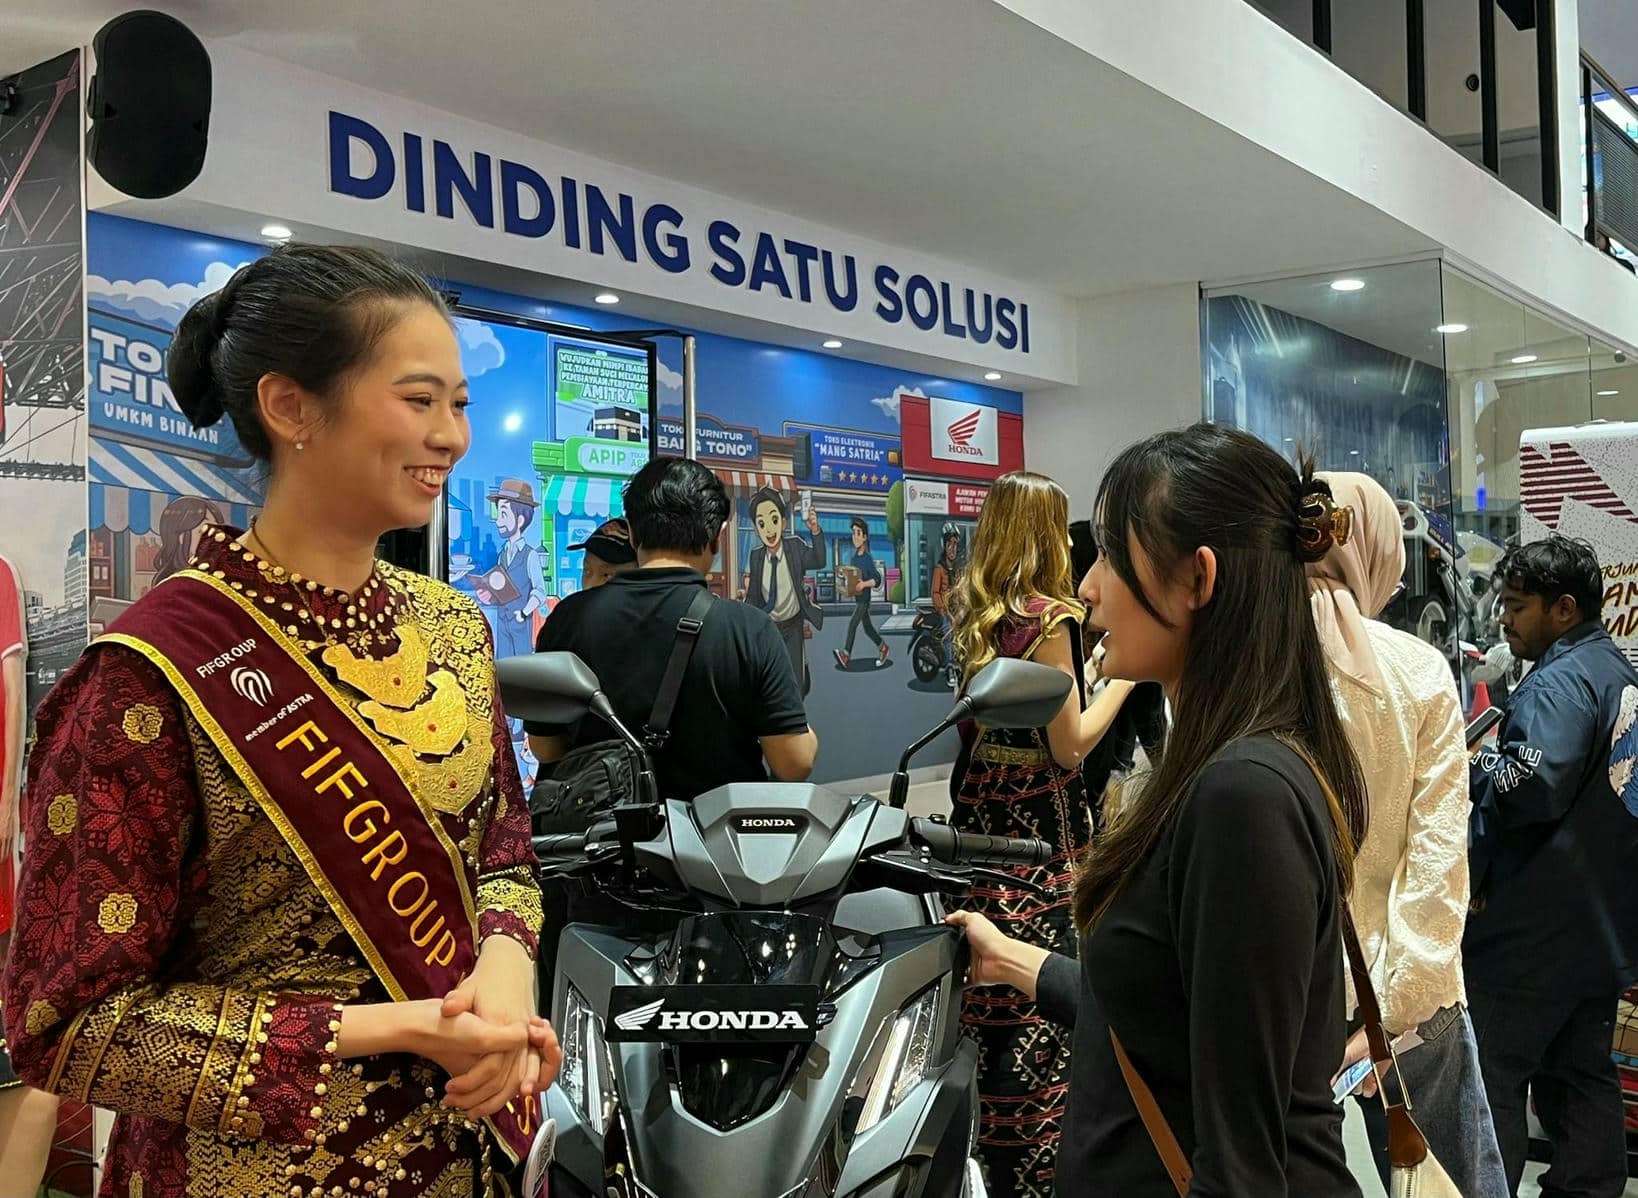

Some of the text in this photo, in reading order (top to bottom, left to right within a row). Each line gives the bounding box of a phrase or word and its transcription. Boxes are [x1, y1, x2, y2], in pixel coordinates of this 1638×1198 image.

[326, 109, 1030, 354] DINDING SATU SOLUSI
[91, 327, 168, 375] TO
[583, 384, 635, 403] AMITRA
[103, 401, 219, 445] UMKM BINAAN
[588, 448, 627, 466] APIP
[948, 444, 983, 457] HONDA
[196, 638, 257, 679] FIFGROUP
[245, 716, 278, 742] member
[287, 693, 314, 714] ASTRA
[741, 818, 796, 828] HONDA
[275, 720, 457, 968] FIFGROUP
[657, 1010, 809, 1031] HONDA
